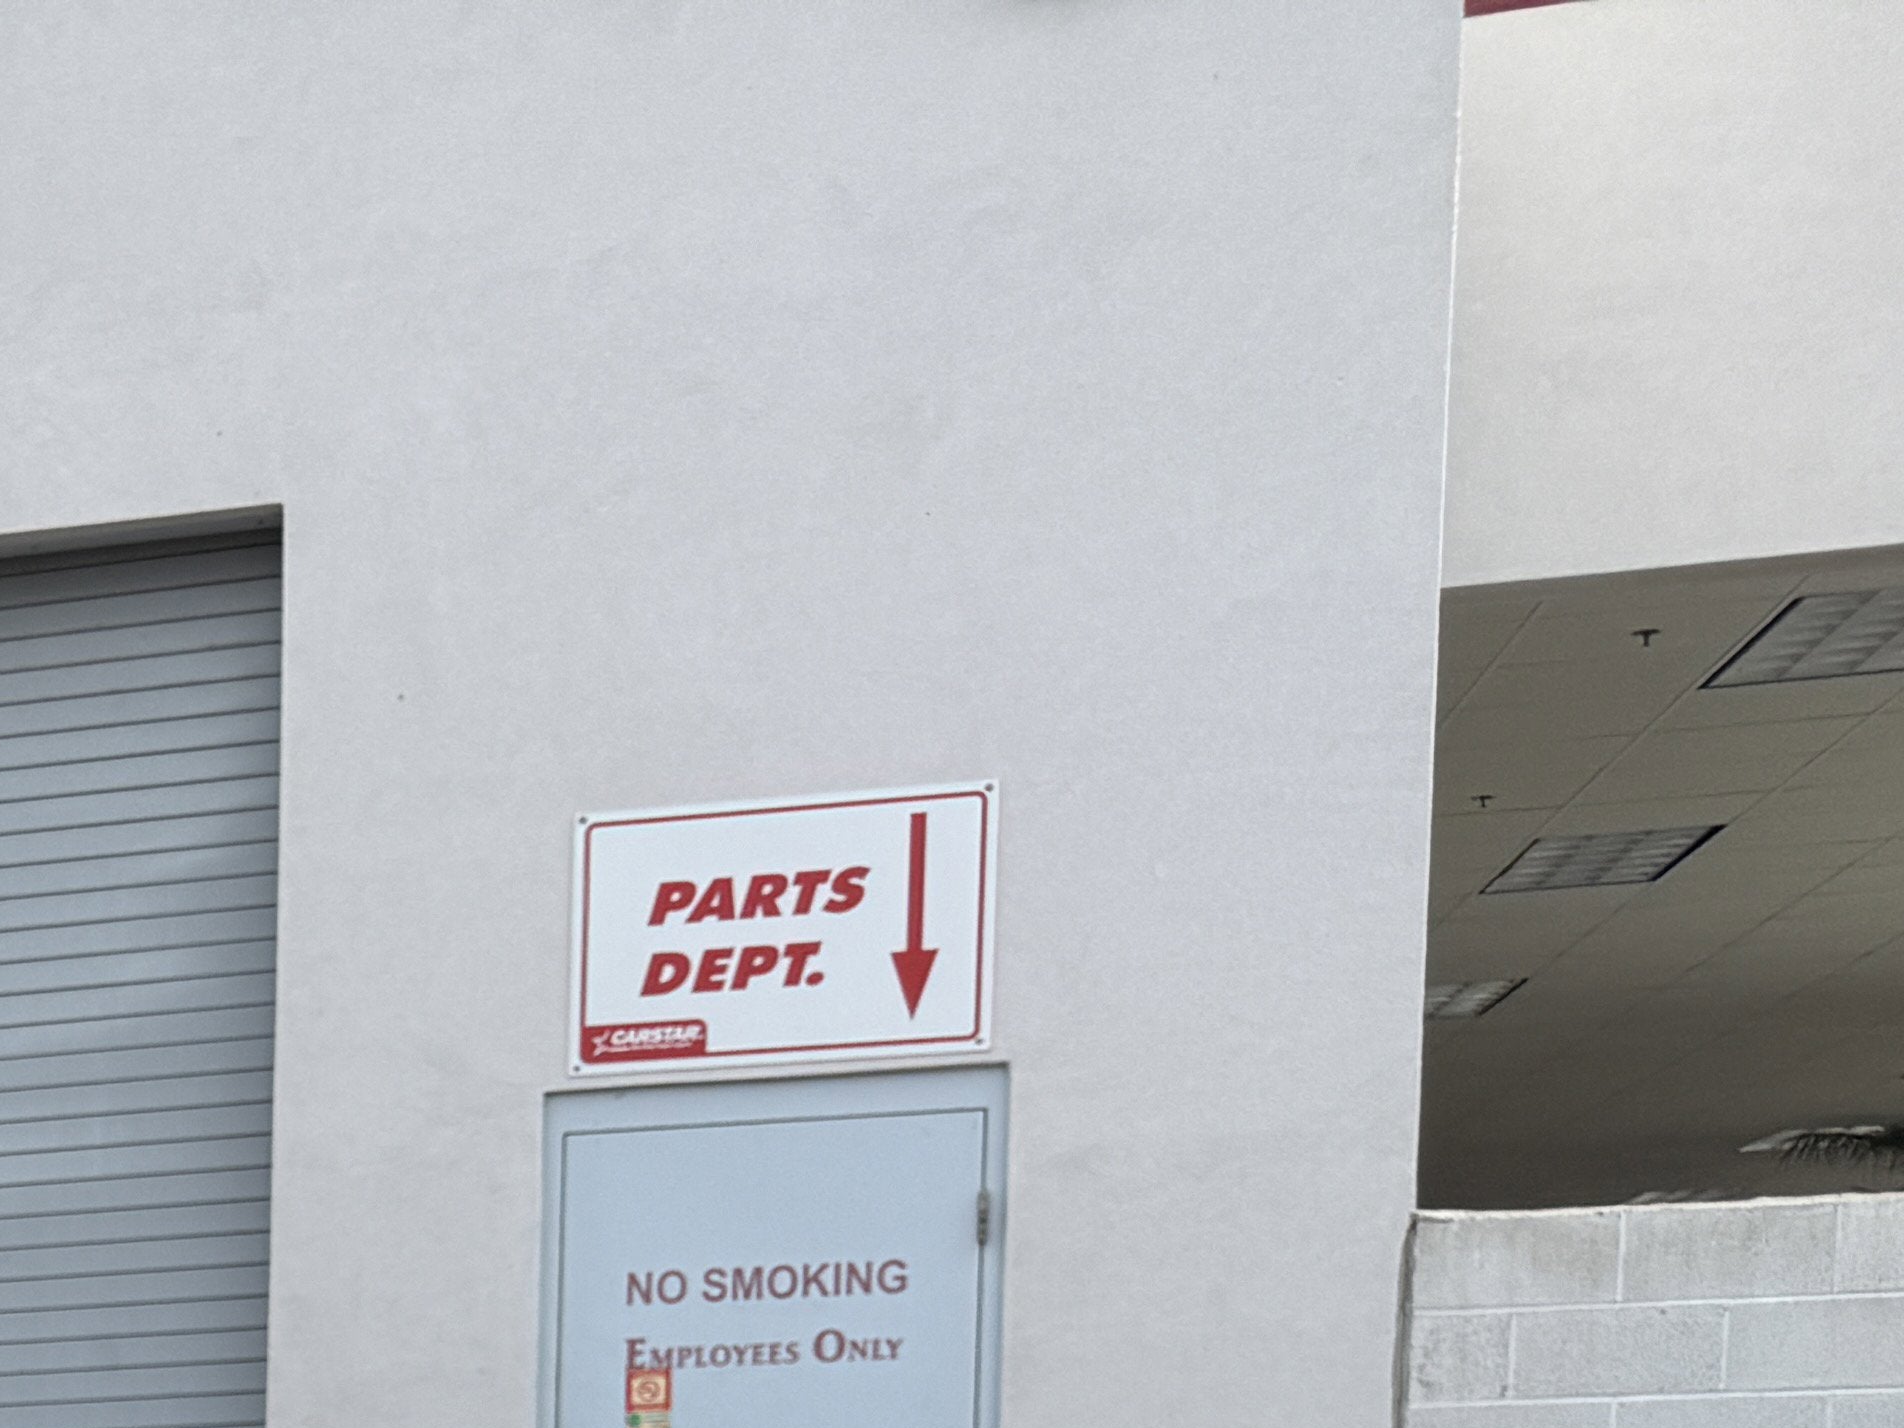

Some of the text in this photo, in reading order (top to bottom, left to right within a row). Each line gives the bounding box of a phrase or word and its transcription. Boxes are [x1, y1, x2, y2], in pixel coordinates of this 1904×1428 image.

[647, 865, 872, 927] PARTS
[639, 940, 825, 998] DEPT.
[625, 1258, 910, 1306] NO SMOKING
